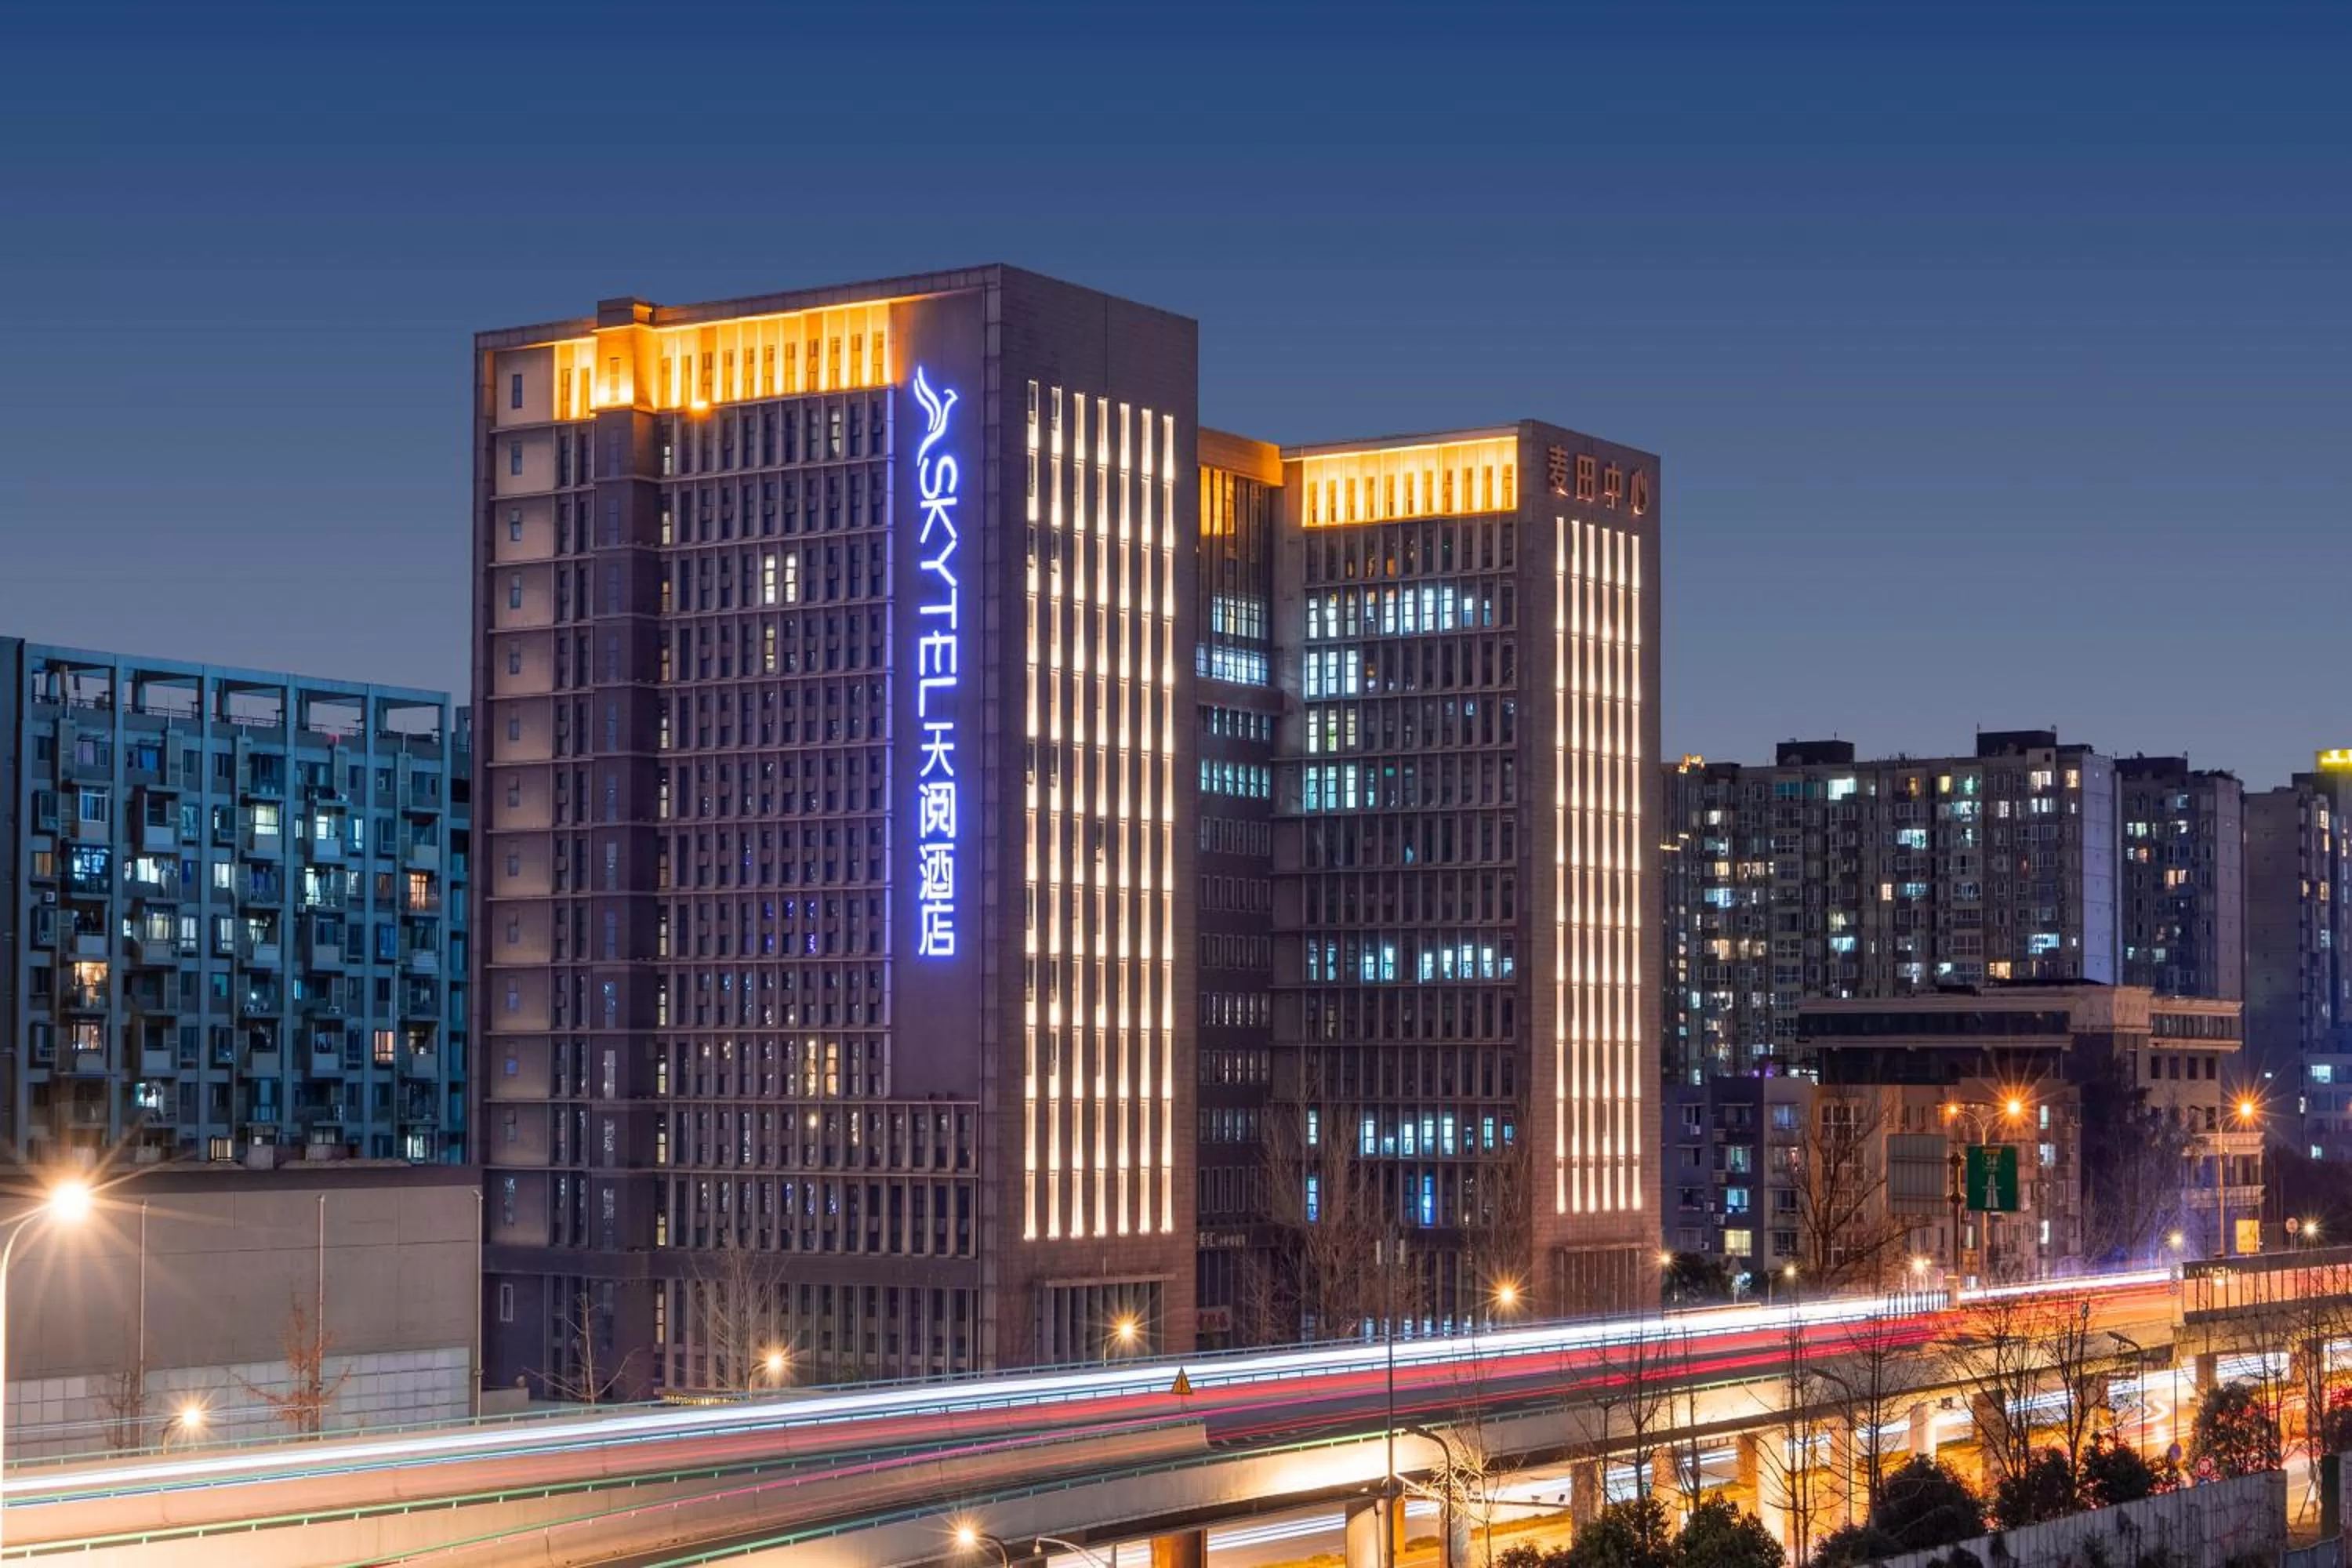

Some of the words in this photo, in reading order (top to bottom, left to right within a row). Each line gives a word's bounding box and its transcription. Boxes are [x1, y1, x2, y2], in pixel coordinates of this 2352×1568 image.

[919, 455, 958, 717] SKYTEL
[1549, 445, 1650, 515] 麦田中心
[918, 722, 956, 956] 天阅酒店
